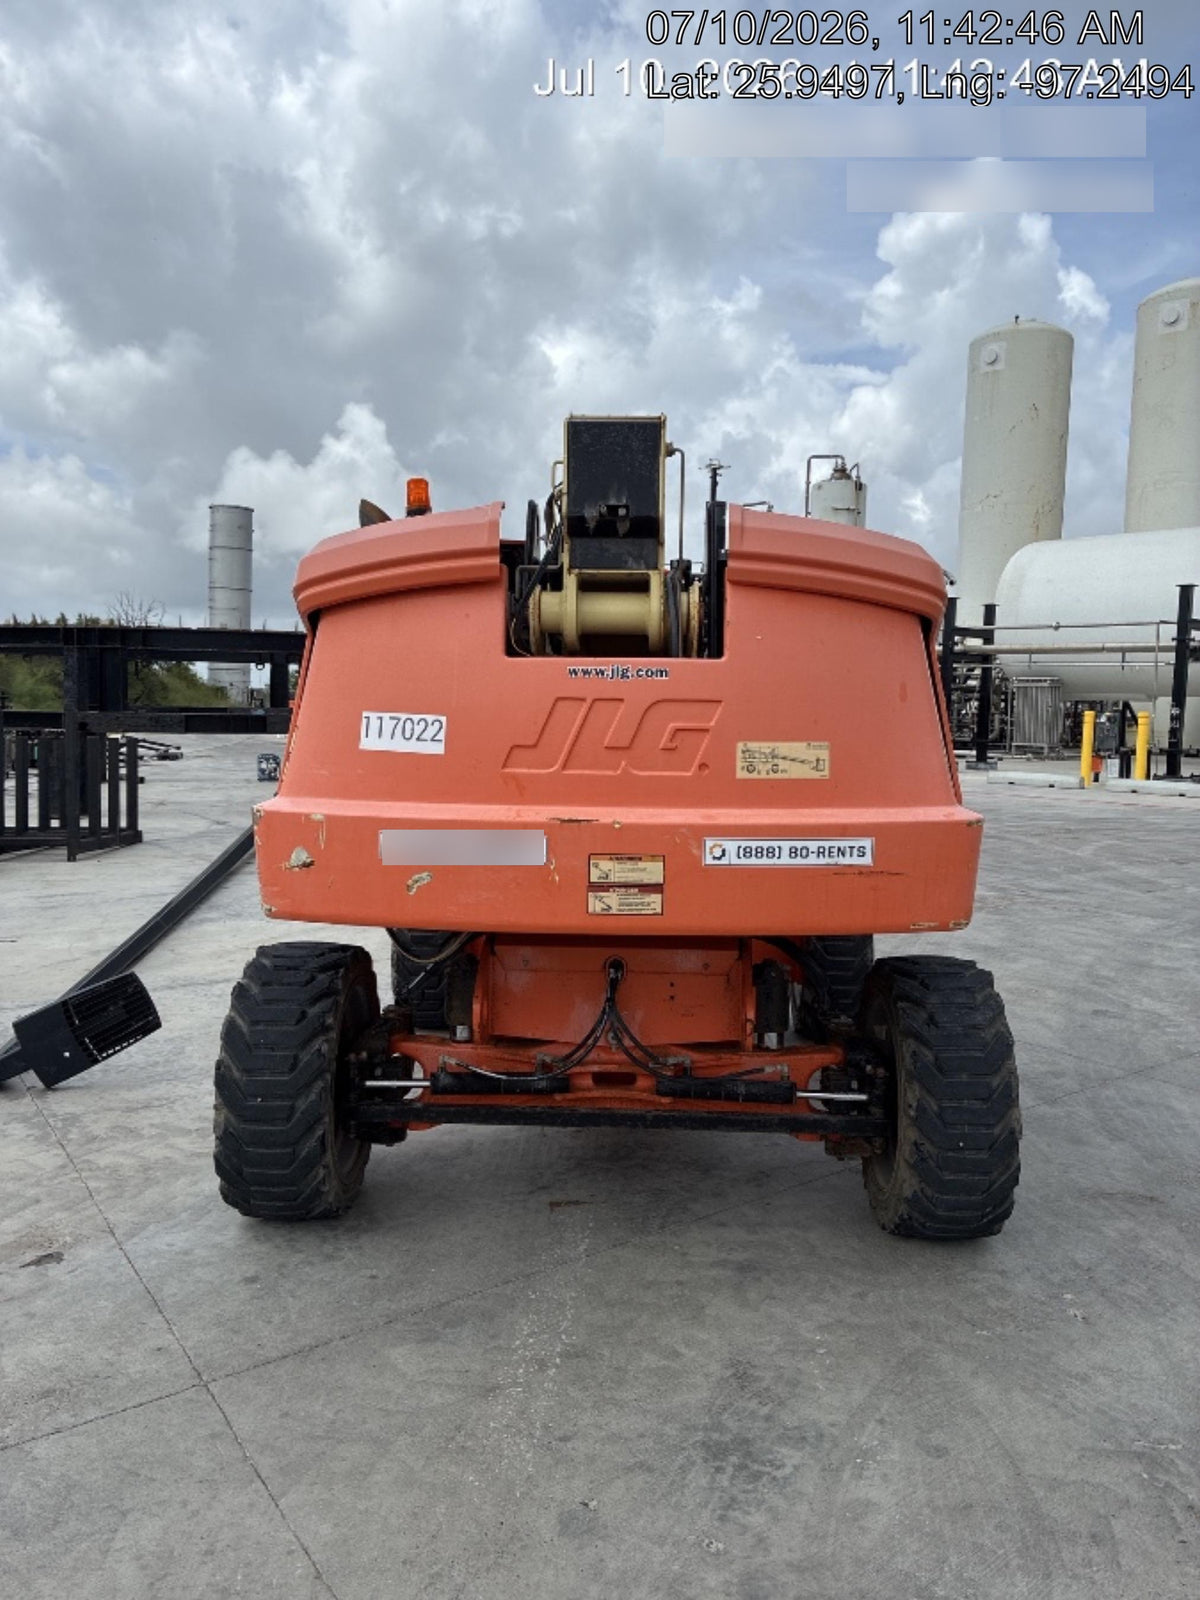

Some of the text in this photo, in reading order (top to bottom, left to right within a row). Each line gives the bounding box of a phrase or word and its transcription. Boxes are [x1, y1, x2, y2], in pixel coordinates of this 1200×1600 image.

[567, 664, 669, 680] www.jlg.com
[363, 716, 444, 742] 117022
[500, 697, 723, 776] JLG
[788, 844, 867, 860] 80-RENTS
